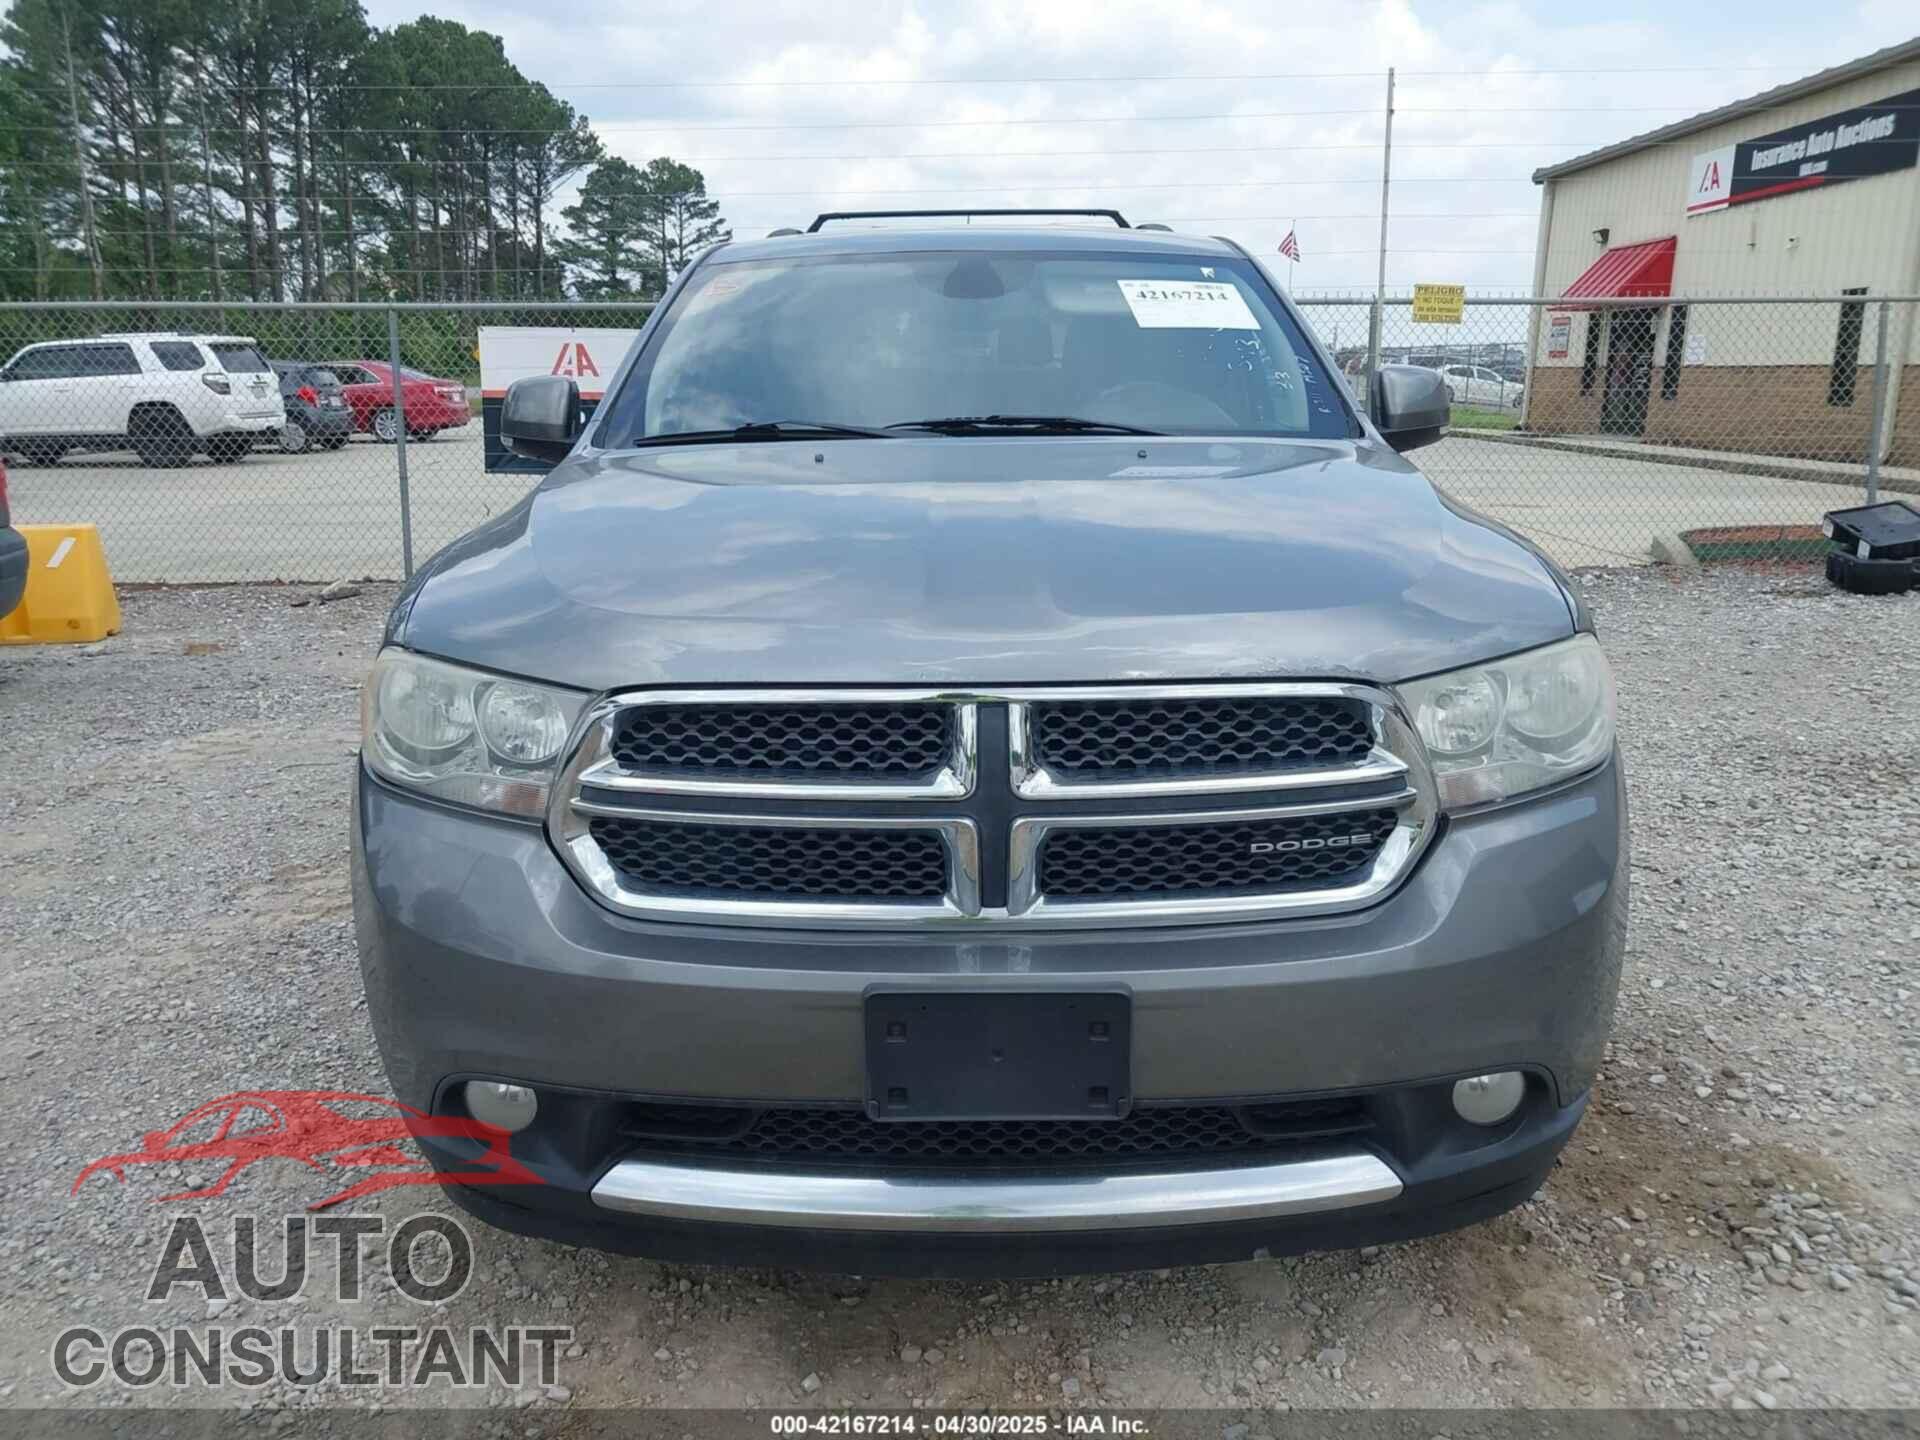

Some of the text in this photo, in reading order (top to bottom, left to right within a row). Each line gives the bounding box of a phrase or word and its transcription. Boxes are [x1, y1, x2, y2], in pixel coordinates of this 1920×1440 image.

[1751, 113, 1896, 171] Insurance Auto Auctions
[1136, 290, 1229, 300] 42167214
[1417, 286, 1464, 296] PELIGRO
[1251, 833, 1372, 853] DODGE
